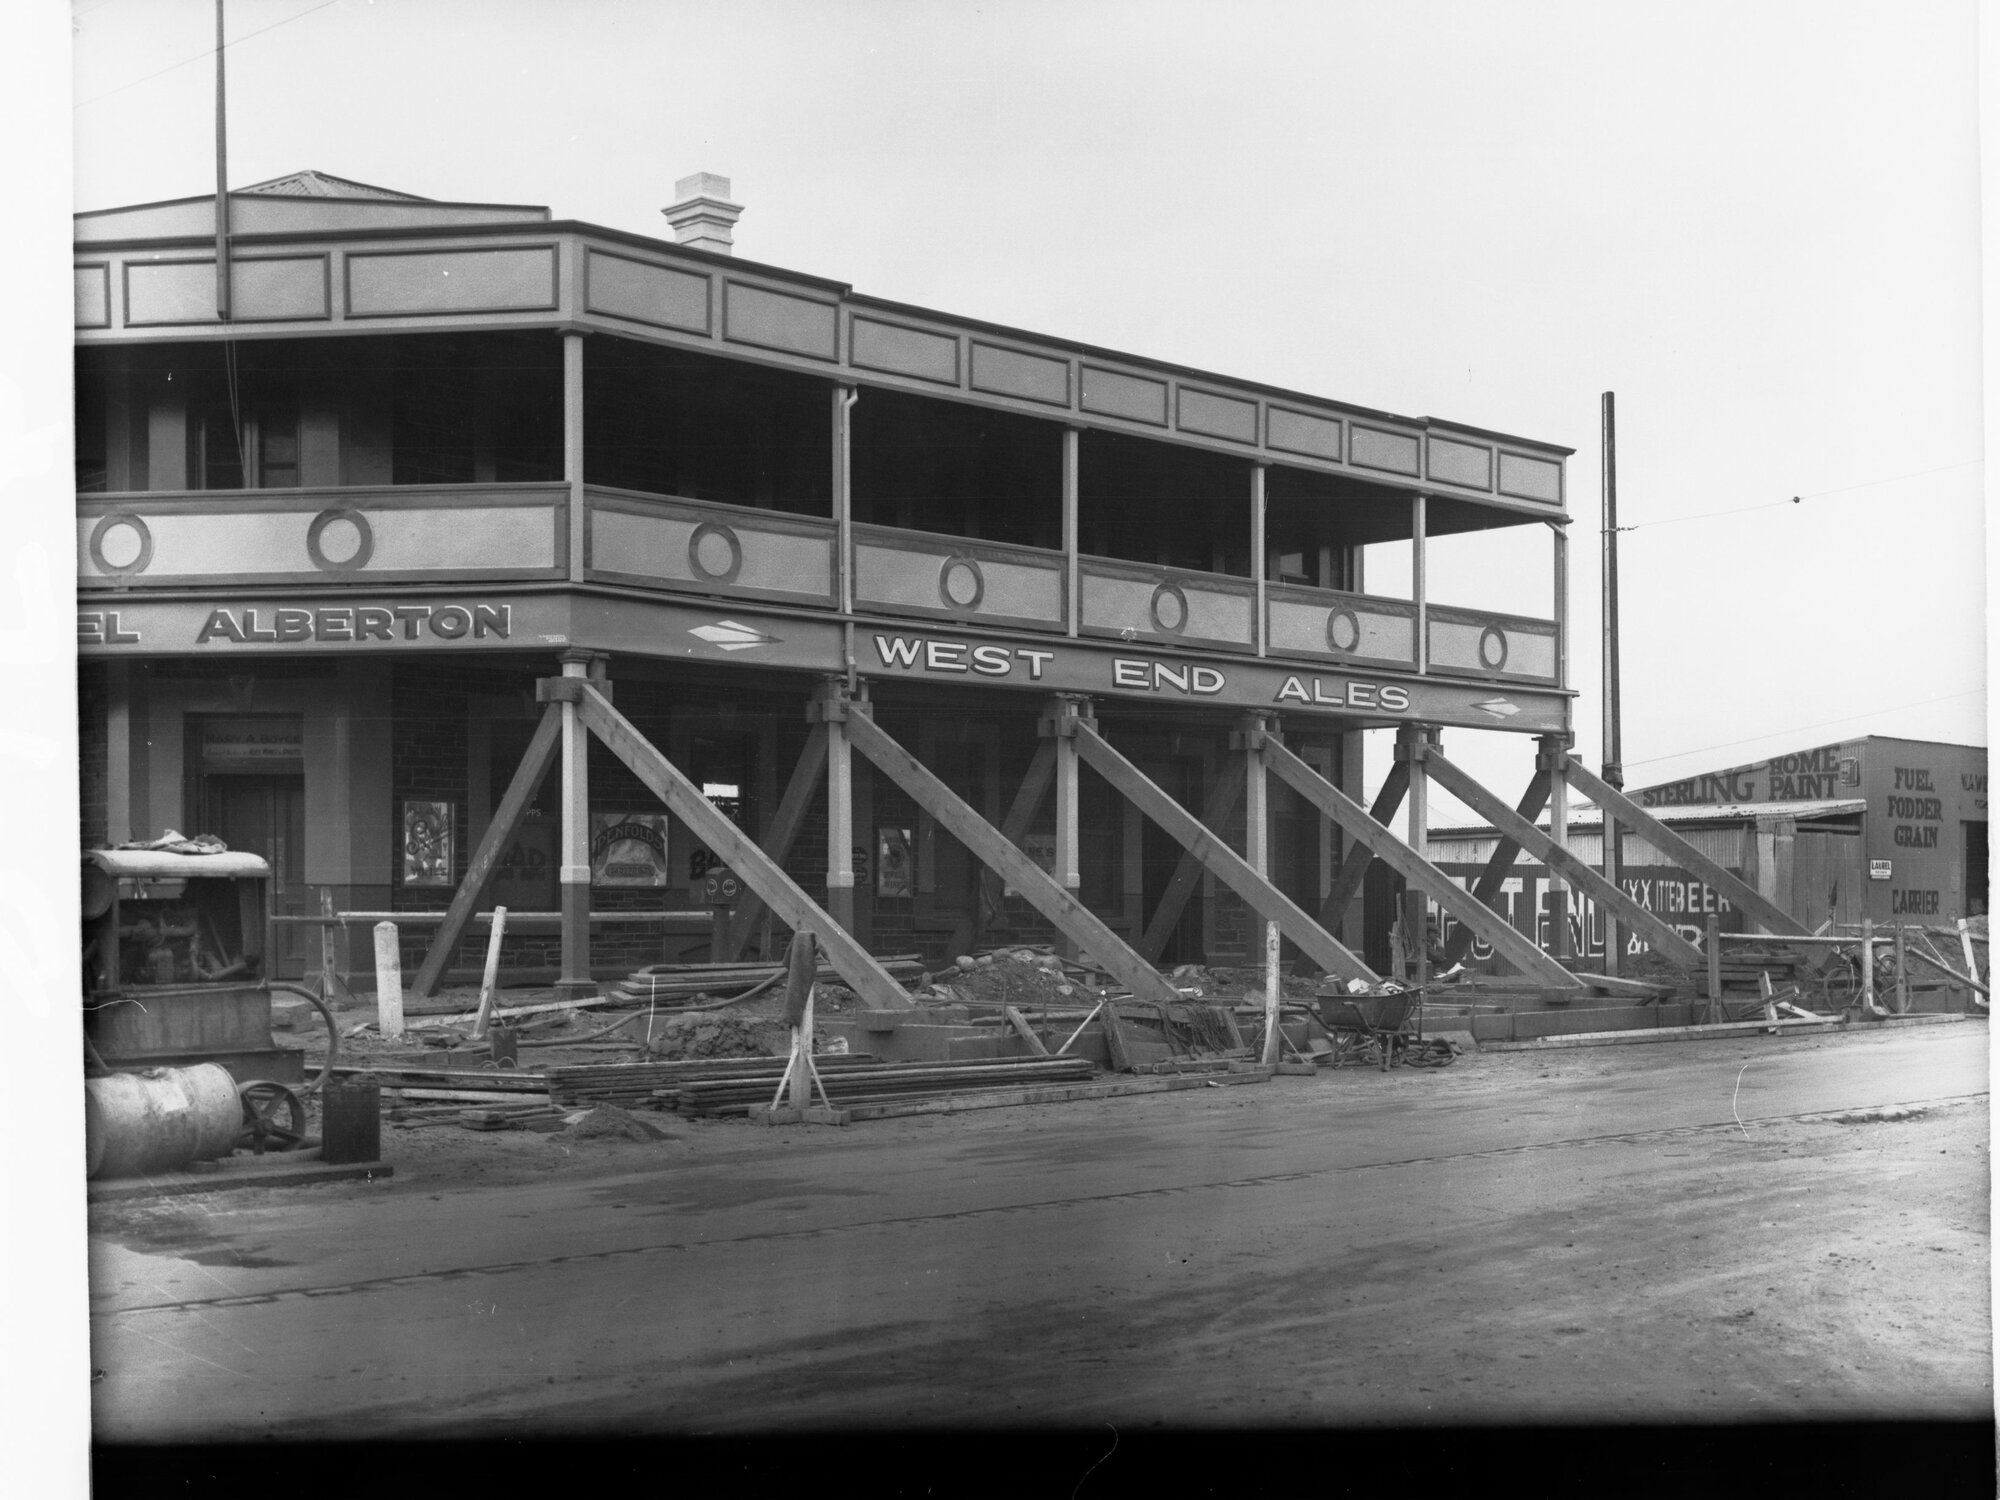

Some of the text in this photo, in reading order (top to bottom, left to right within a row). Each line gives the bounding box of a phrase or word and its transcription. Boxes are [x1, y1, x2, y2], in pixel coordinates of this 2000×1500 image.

[194, 604, 512, 645] ALBERTON
[872, 634, 1411, 713] WEST END ALES
[1768, 744, 1841, 775] HOME
[1642, 771, 1839, 807] STERLING PAINT
[1894, 824, 1939, 849] GRAIN
[1891, 889, 1940, 915] CARRIER
